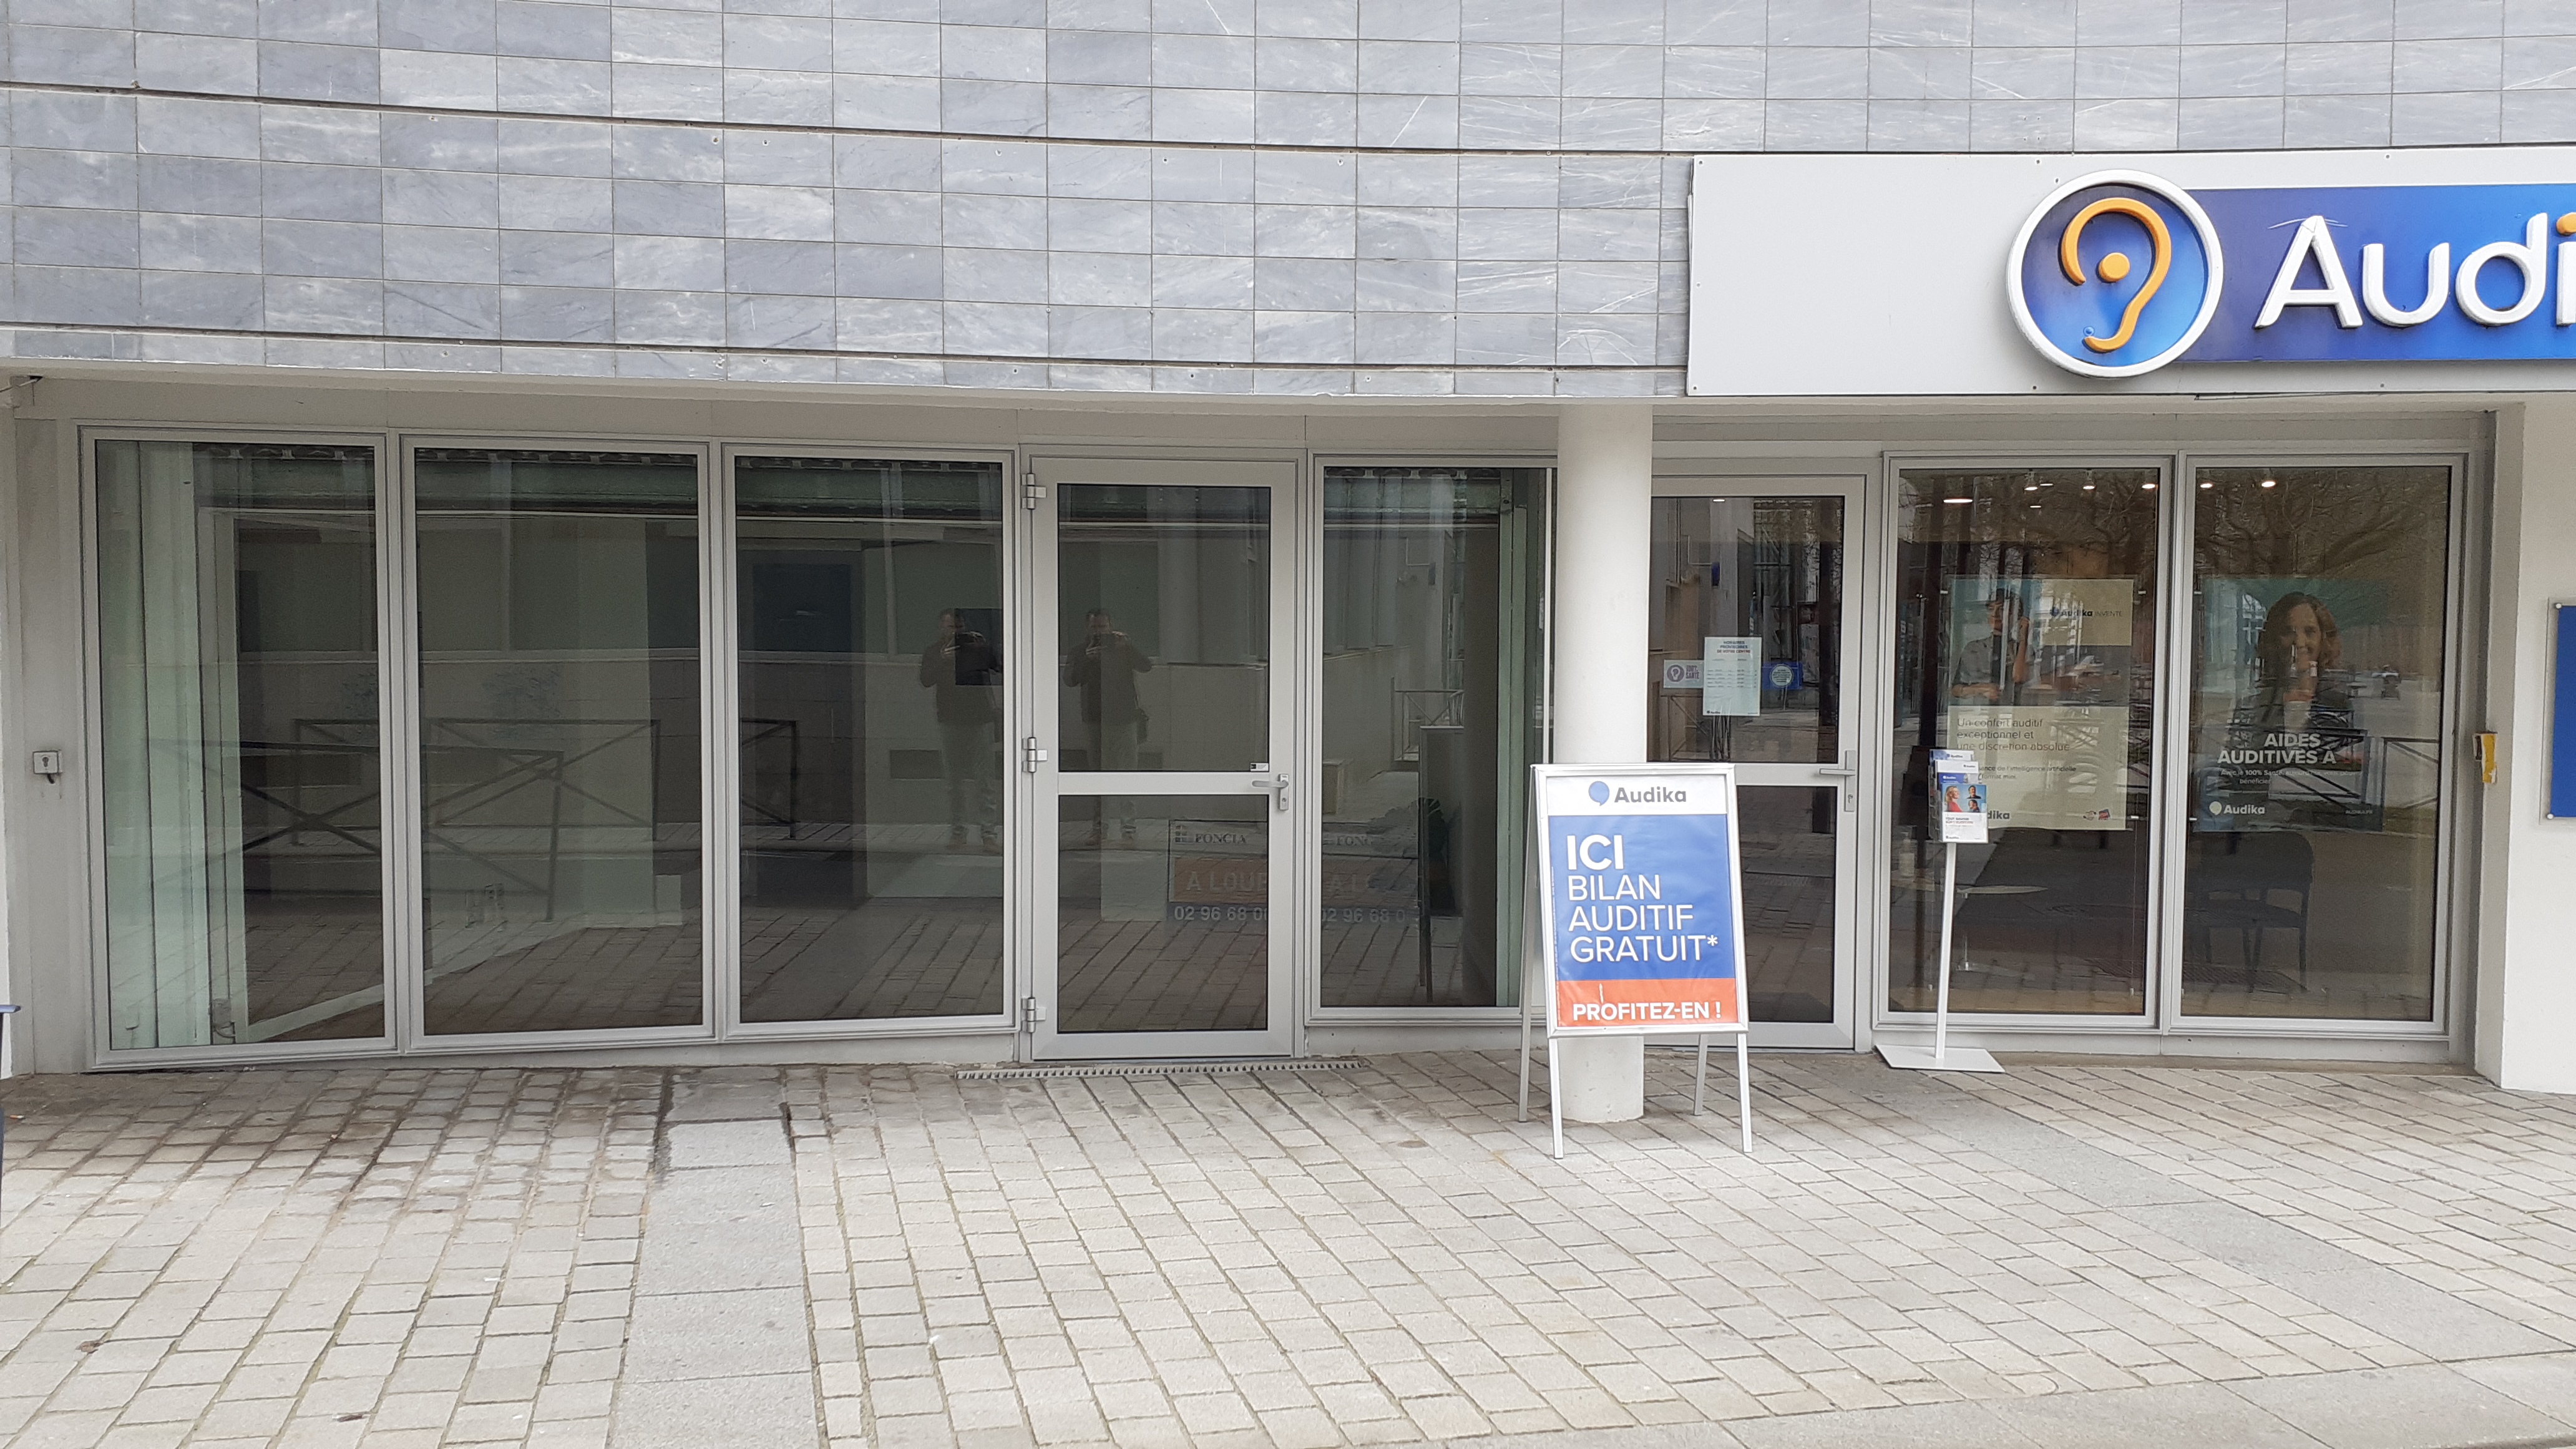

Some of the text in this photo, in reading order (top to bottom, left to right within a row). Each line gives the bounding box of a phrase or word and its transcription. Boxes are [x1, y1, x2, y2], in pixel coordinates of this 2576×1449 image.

[2254, 212, 2576, 328] Audi
[1958, 718, 2043, 727] Un confort auditif
[1957, 731, 2034, 741] exceptionnel et
[2264, 733, 2321, 748] AIDES
[2031, 743, 2070, 751] absolue
[2217, 750, 2318, 764] AUDITIVES
[1614, 786, 1687, 803] Audika
[1988, 811, 2010, 819] dika
[2223, 804, 2265, 814] Audika
[1195, 832, 1247, 844] FONCIA
[1567, 834, 1624, 871] ICI
[1568, 874, 1661, 900] BILAN
[1174, 905, 1195, 920] 02
[1201, 906, 1221, 921] 96
[1227, 907, 1247, 921] 68
[1342, 908, 1364, 923] 96
[1568, 904, 1694, 932] AUDITIF
[1573, 1002, 1722, 1020] PROFITEZ-EN !
